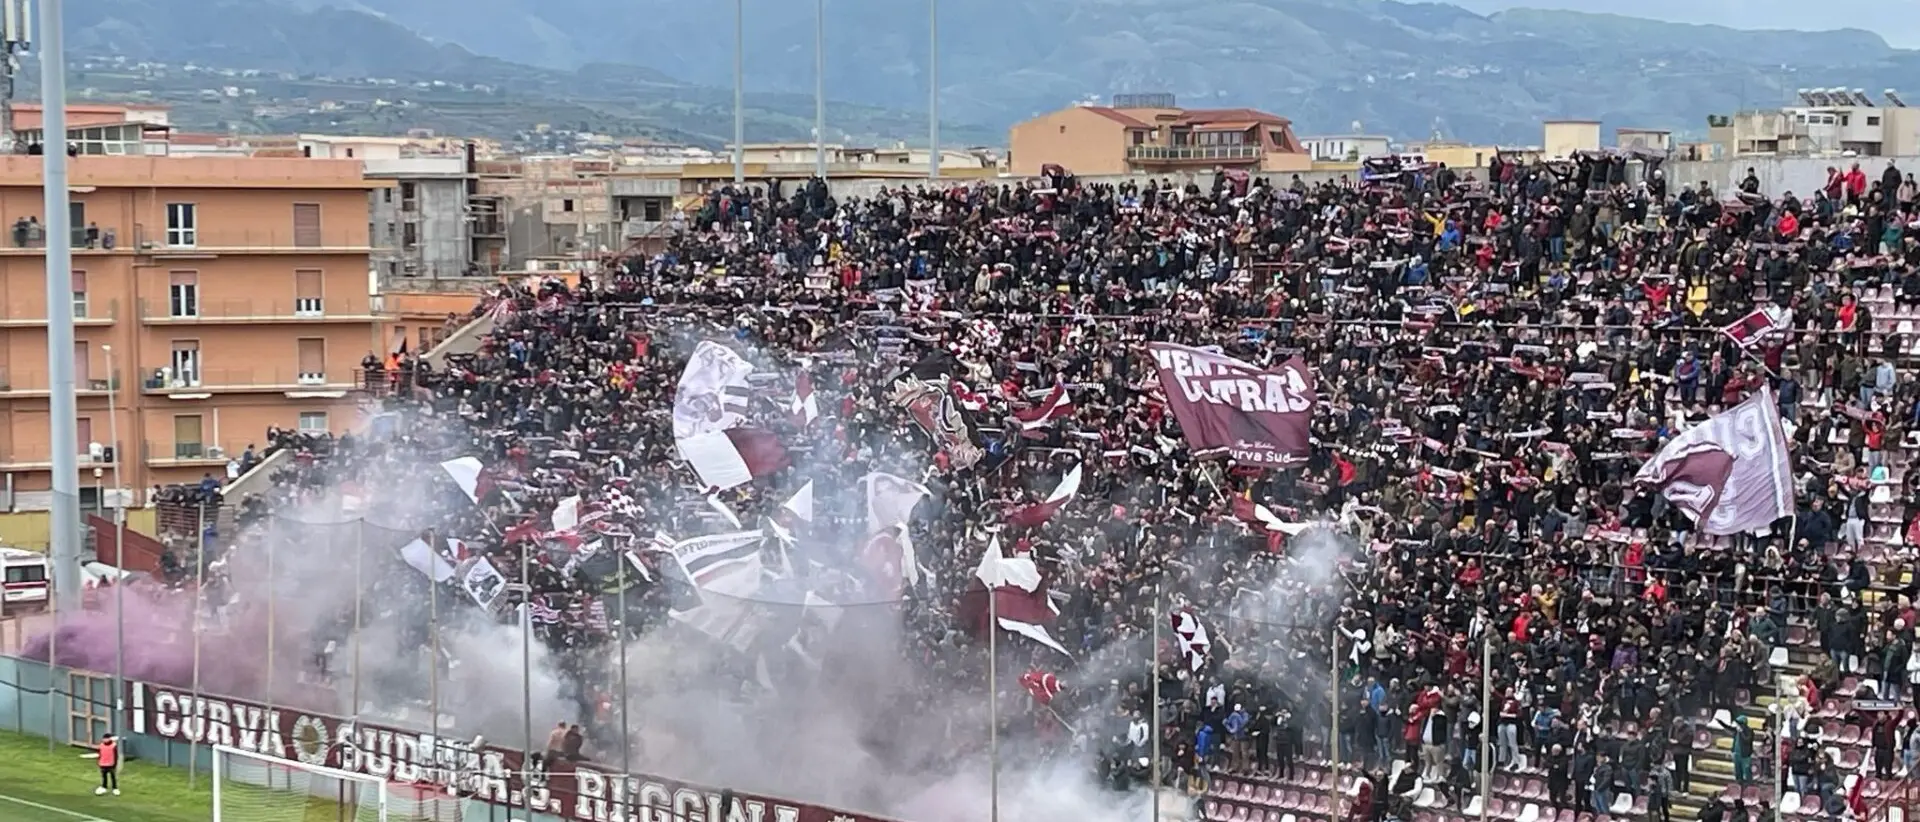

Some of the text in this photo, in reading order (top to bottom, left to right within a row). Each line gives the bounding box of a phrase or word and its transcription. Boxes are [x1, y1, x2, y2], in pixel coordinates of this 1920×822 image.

[1229, 449, 1291, 463] urva Sud
[155, 690, 286, 758] CURVA
[332, 722, 420, 782] SUD
